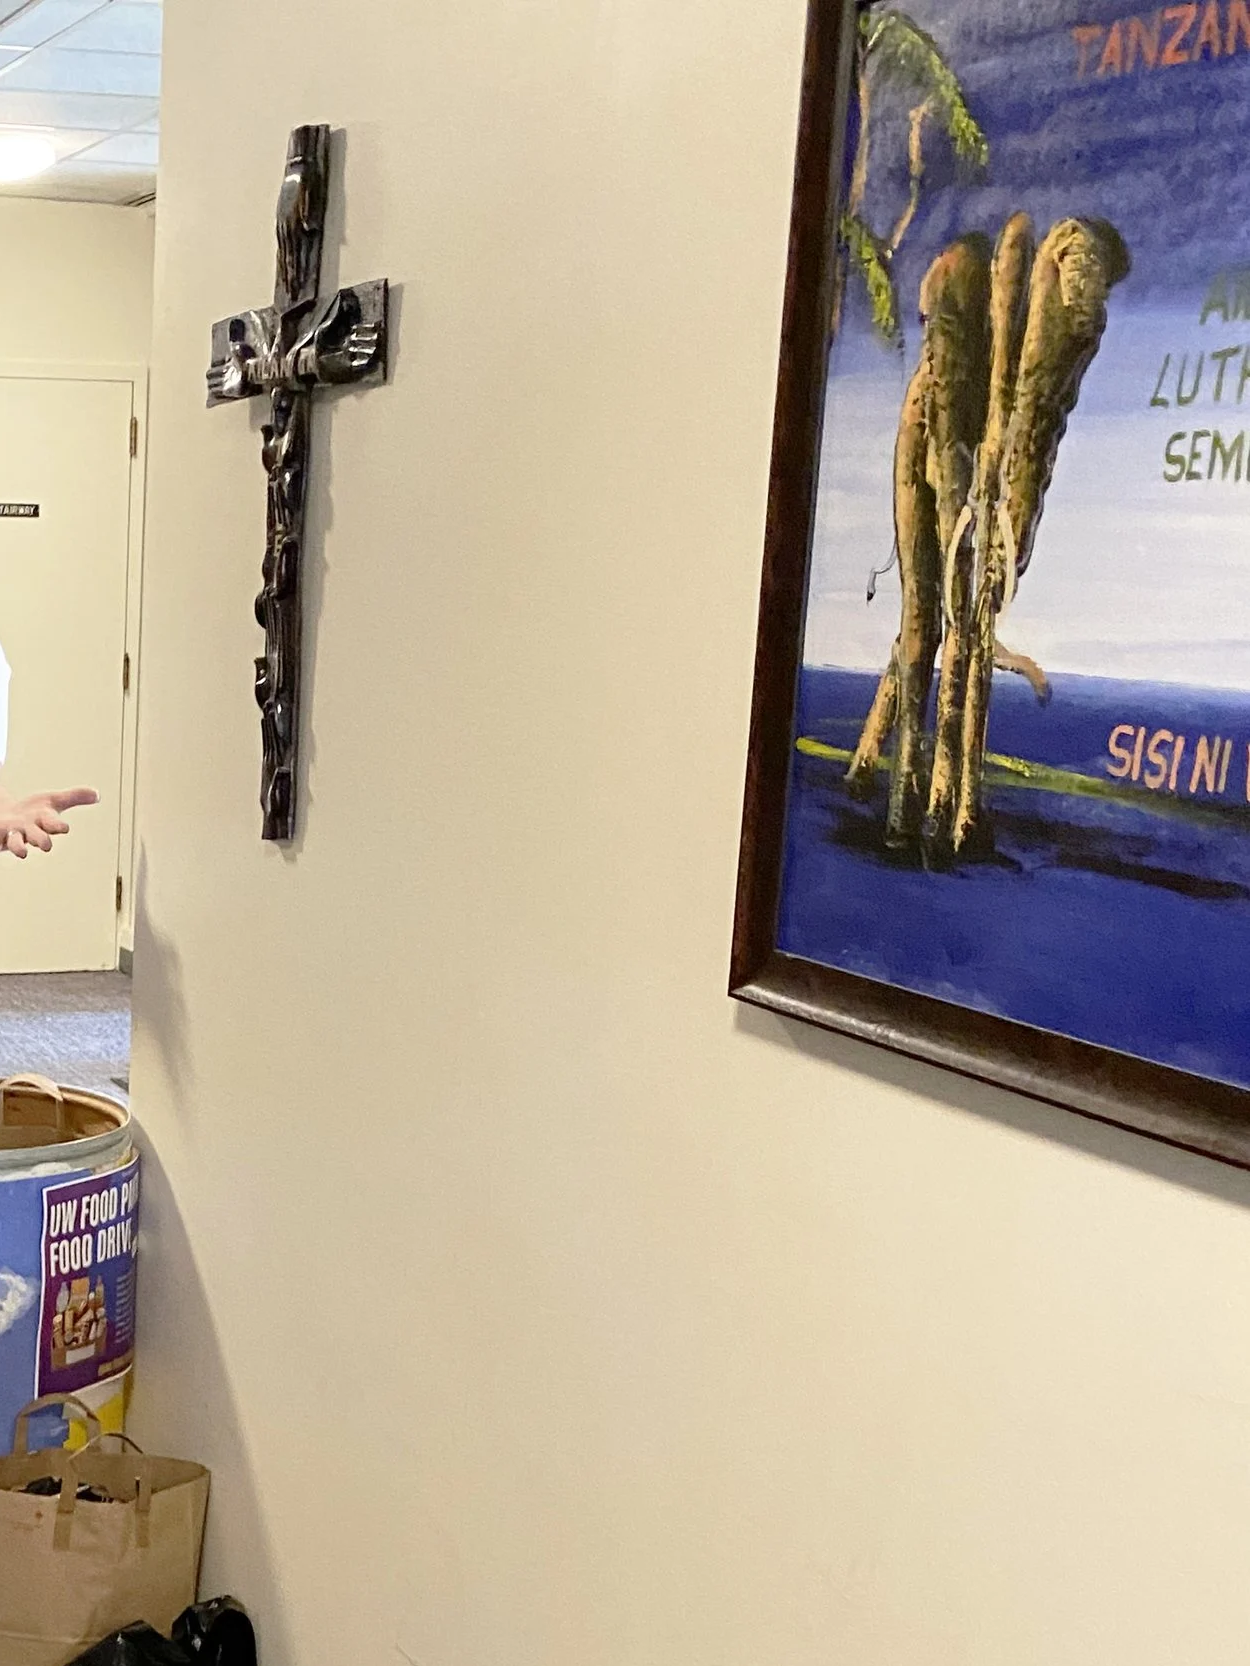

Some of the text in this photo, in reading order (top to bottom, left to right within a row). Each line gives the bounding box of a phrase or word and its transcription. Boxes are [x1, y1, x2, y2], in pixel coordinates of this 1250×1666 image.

[1106, 724, 1185, 790] SISI
[1189, 735, 1232, 793] NI
[50, 1199, 77, 1238] UW
[80, 1187, 118, 1230] FOOD
[51, 1217, 132, 1277] FOOD DRIV
